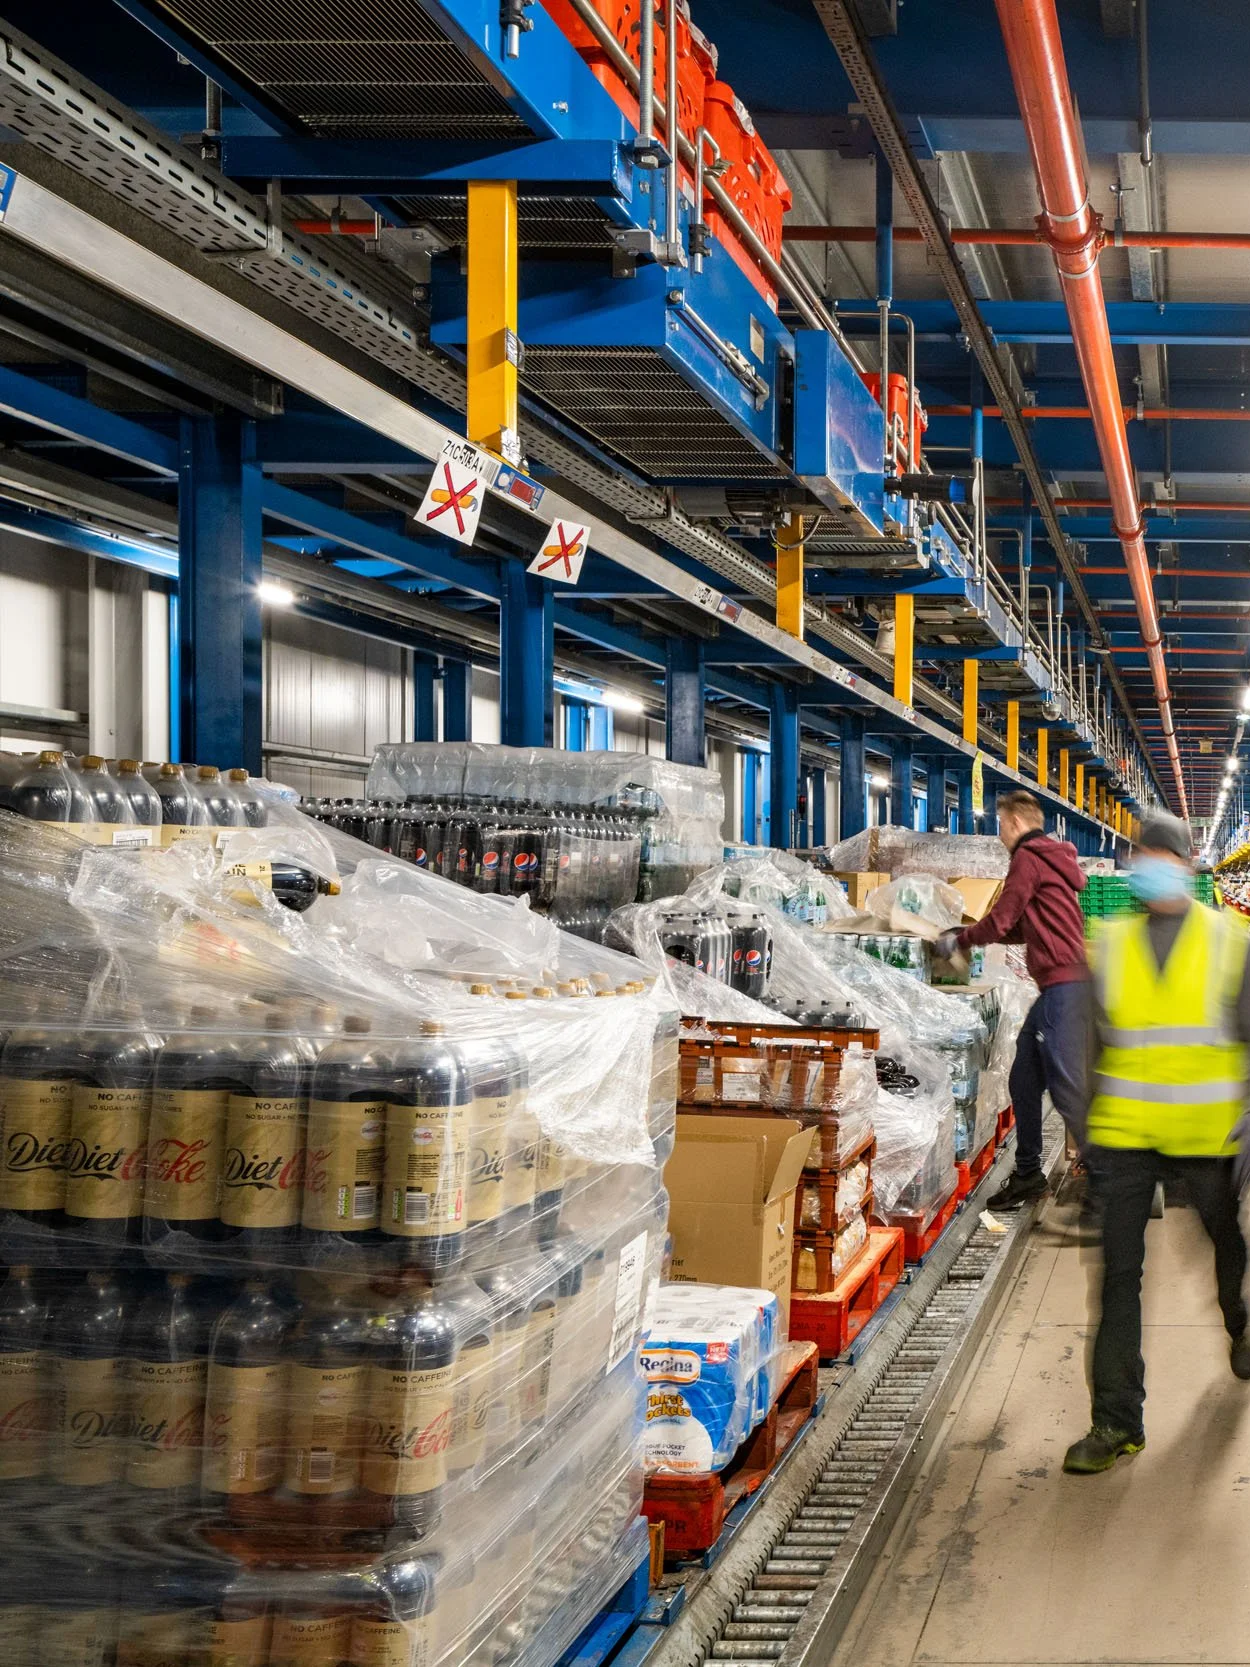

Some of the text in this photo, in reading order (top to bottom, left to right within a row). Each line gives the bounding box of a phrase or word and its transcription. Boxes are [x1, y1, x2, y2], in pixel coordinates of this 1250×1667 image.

[97, 1093, 114, 1101] NO
[255, 1102, 272, 1111] NO
[226, 1147, 284, 1182] Diet
[639, 1357, 694, 1374] Regina
[392, 1374, 408, 1384] NO
